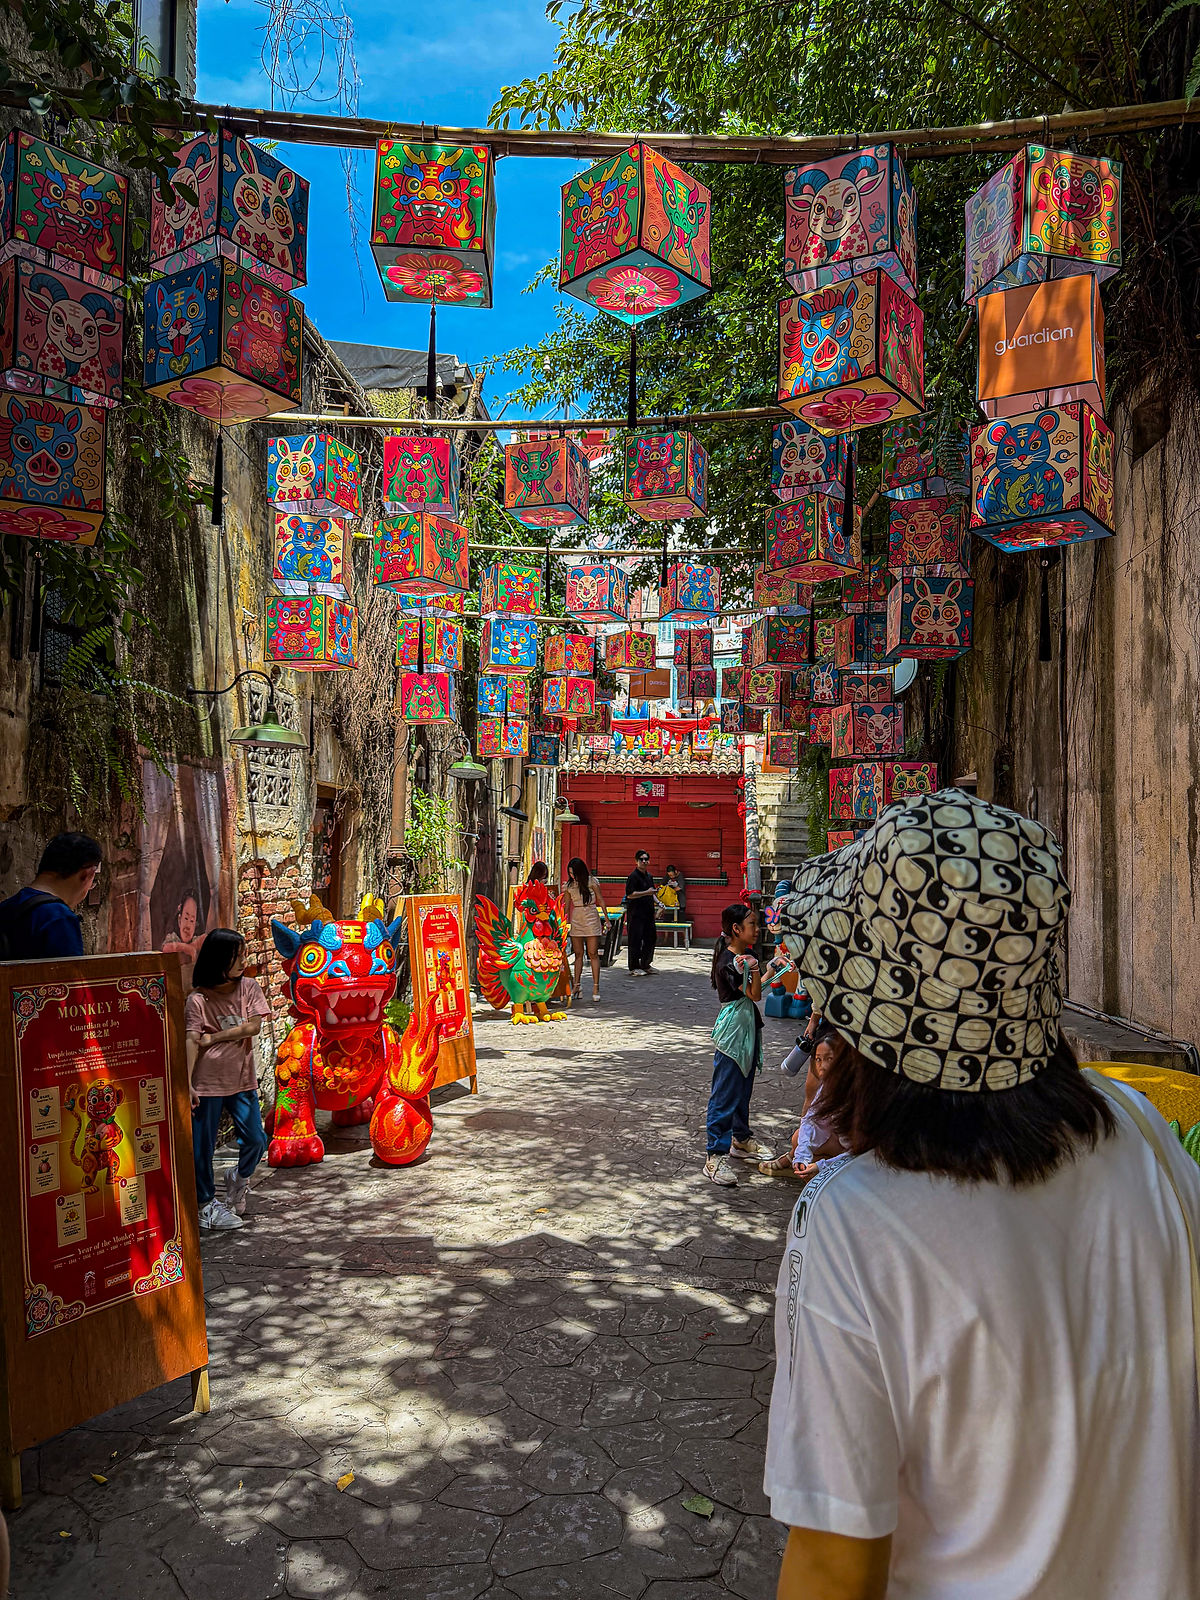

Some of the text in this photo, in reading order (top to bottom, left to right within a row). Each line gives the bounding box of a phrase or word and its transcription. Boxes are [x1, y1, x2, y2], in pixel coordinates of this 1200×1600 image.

[426, 166, 439, 179] 王
[1070, 162, 1083, 177] 王
[67, 178, 81, 195] 王
[262, 179, 273, 196] 王
[593, 186, 602, 201] 王
[677, 184, 686, 203] 王
[828, 184, 840, 197] 王
[173, 290, 185, 308] 王
[262, 287, 273, 303] 王
[68, 304, 81, 318] 王
[994, 326, 1074, 356] guardian
[40, 427, 51, 438] 王
[1017, 428, 1029, 438] 王
[342, 925, 362, 943] 王
[58, 998, 130, 1020] MONKEY 猴
[70, 1019, 120, 1032] Guardian of Joy
[47, 1050, 77, 1060] Auspicious
[78, 1046, 112, 1056] Significance
[77, 1246, 92, 1254] Year
[94, 1242, 99, 1250] of
[102, 1240, 111, 1248] the
[113, 1233, 135, 1243] Monkey
[107, 1273, 129, 1287] guardian
